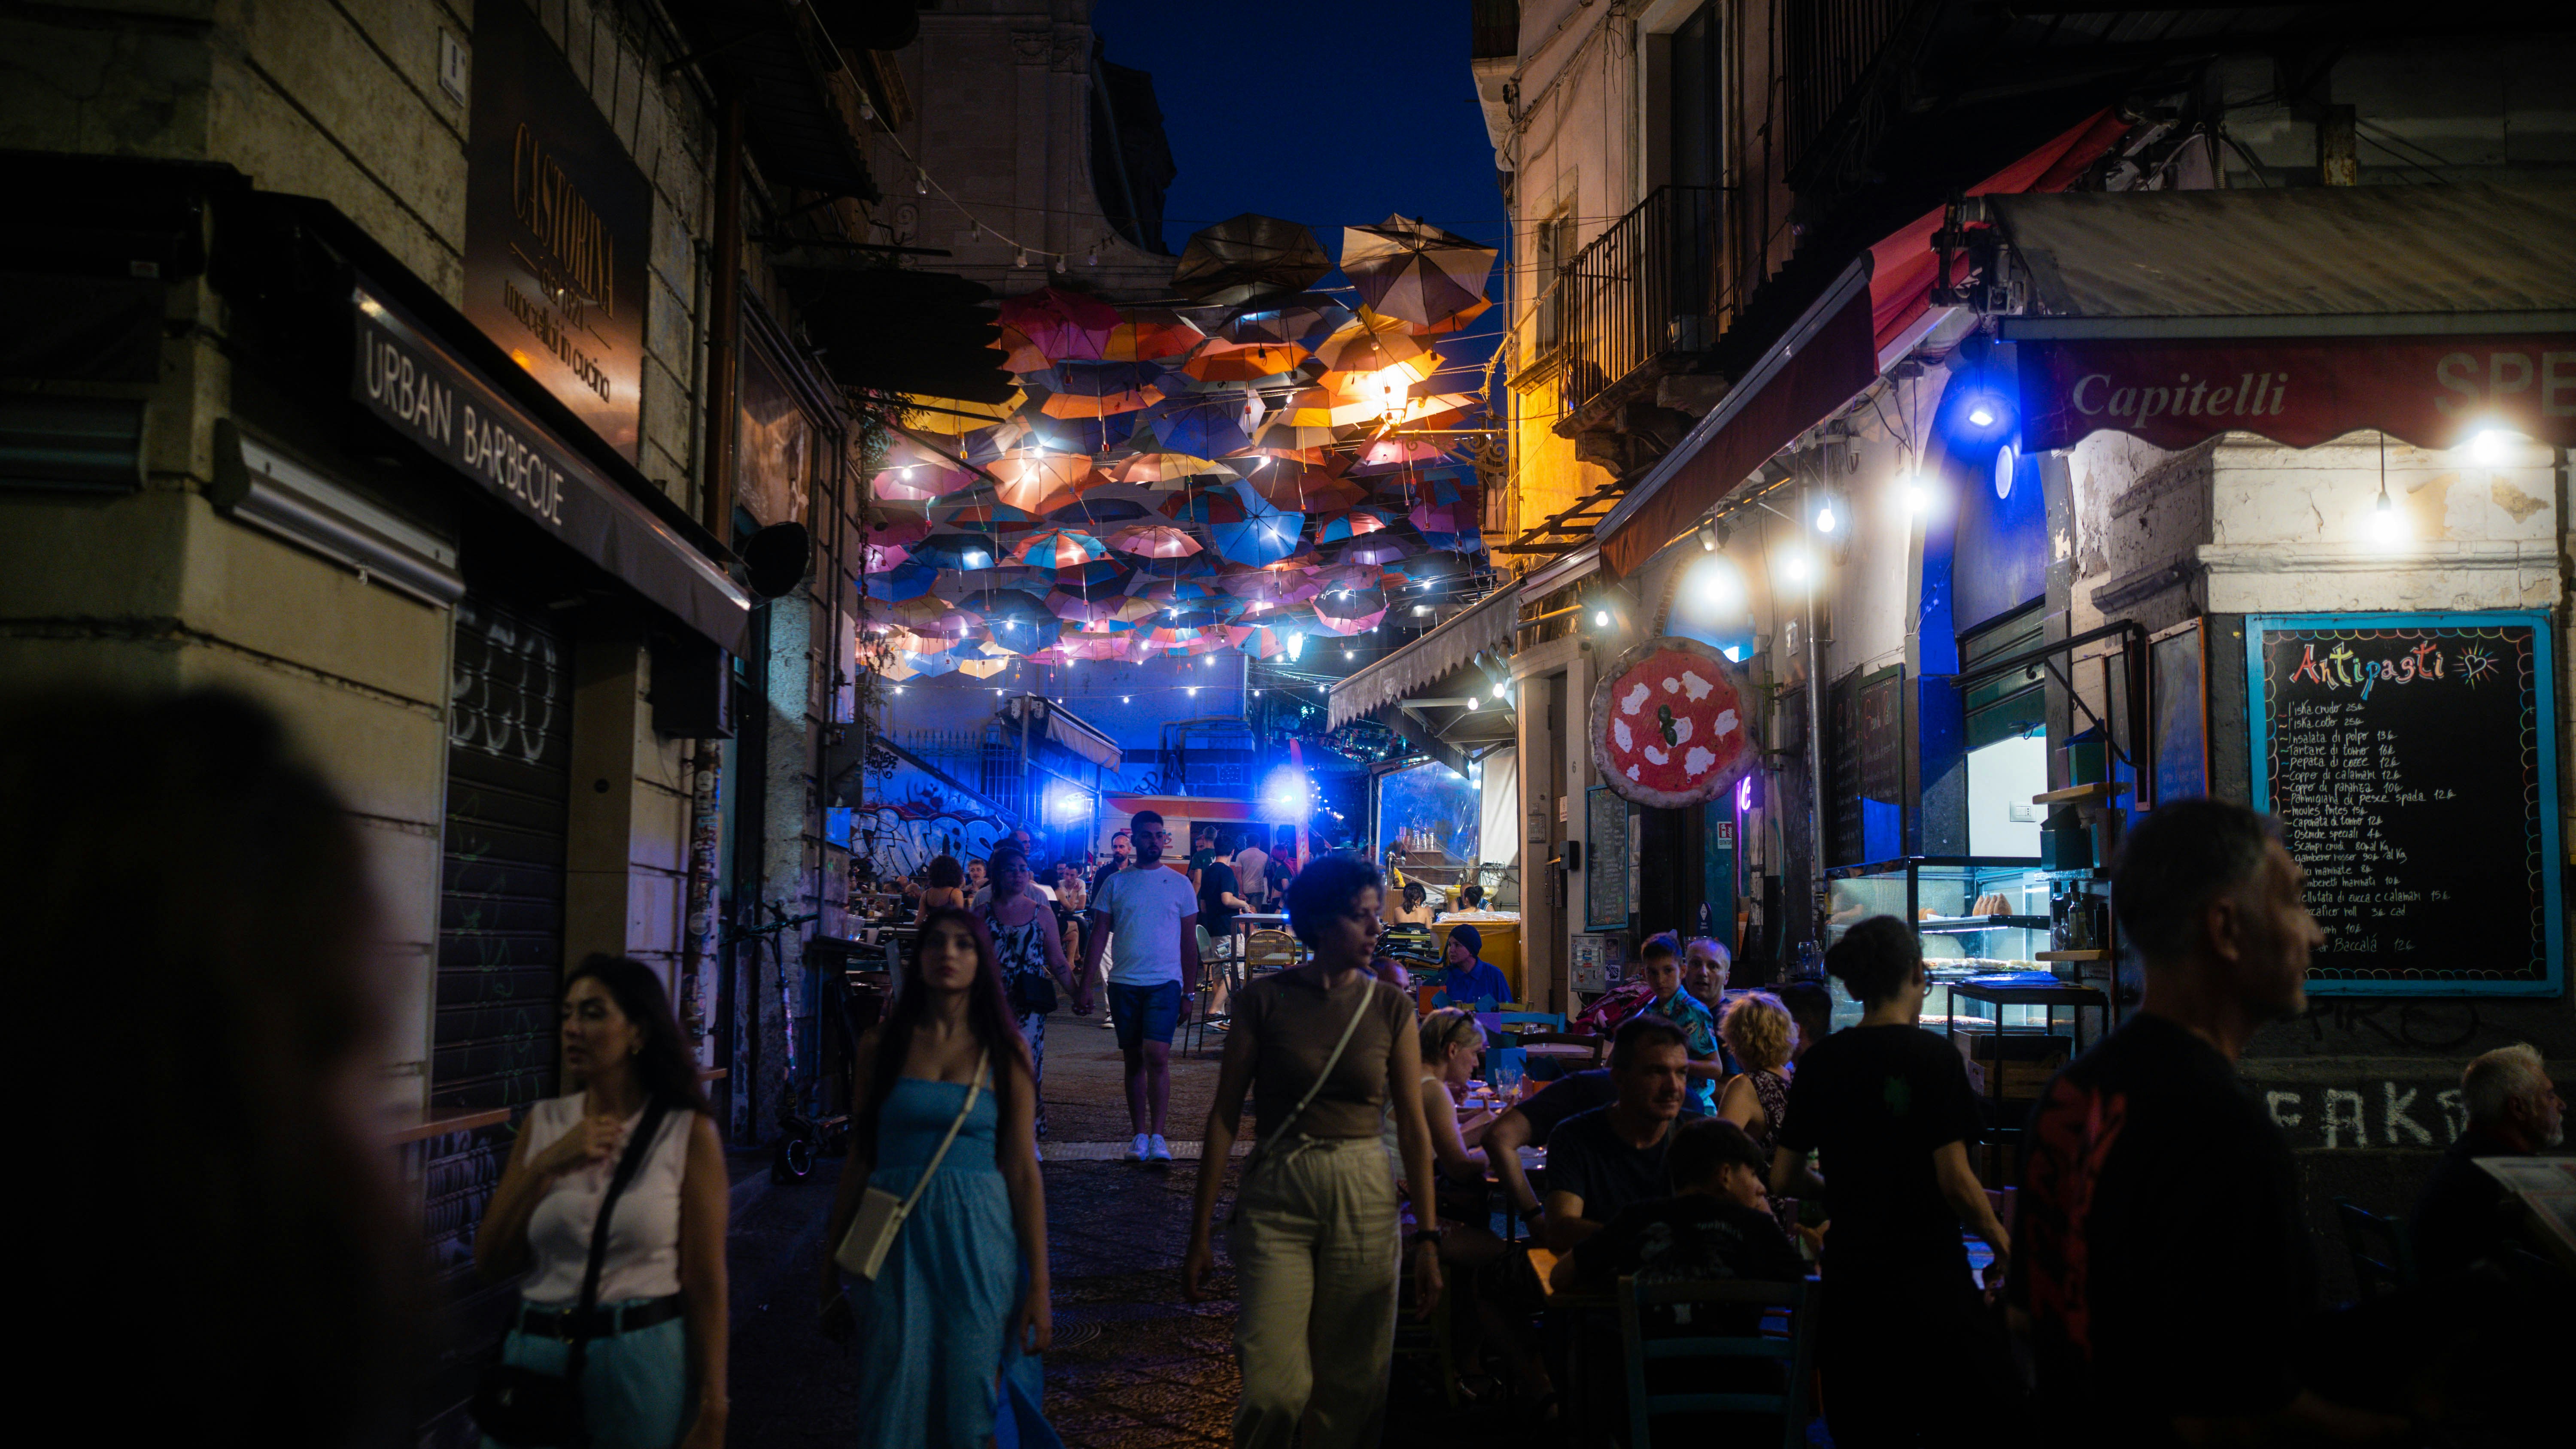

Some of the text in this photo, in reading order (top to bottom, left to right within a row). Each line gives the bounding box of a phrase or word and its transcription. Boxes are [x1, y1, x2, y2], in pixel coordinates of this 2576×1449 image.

[513, 122, 613, 320] CASTORINA
[560, 324, 571, 367] in
[573, 349, 610, 403] cucina
[2072, 372, 2290, 429] Capitelli
[366, 330, 564, 527] URBAN BARBECUE
[2290, 640, 2445, 700] Antipasti
[2289, 731, 2327, 743] Insalata
[2332, 730, 2340, 743] di
[2345, 728, 2369, 746] polpo
[2287, 745, 2326, 755] Tartare
[2330, 744, 2338, 755] di
[2343, 744, 2369, 755] tonno
[1572, 761, 1577, 773] 6
[2330, 756, 2338, 767] di
[2323, 768, 2330, 779] di
[2336, 768, 2376, 780] calamari
[2319, 779, 2327, 792] di
[2334, 782, 2374, 797] paranza
[2344, 792, 2354, 805] di
[2360, 794, 2390, 806] pesce
[2396, 789, 2427, 806] spada
[2331, 815, 2339, 826] di
[2341, 815, 2363, 825] tonno
[2330, 827, 2358, 841] speciali
[2298, 864, 2312, 876] lici
[2315, 864, 2353, 876] marinate
[2306, 877, 2337, 888] mberetti
[2342, 876, 2376, 887] marinati
[2301, 890, 2333, 903] ellutata
[2337, 890, 2345, 902] di
[2375, 893, 2382, 902] e
[2384, 888, 2422, 901] calamari
[2344, 906, 2357, 917] roll
